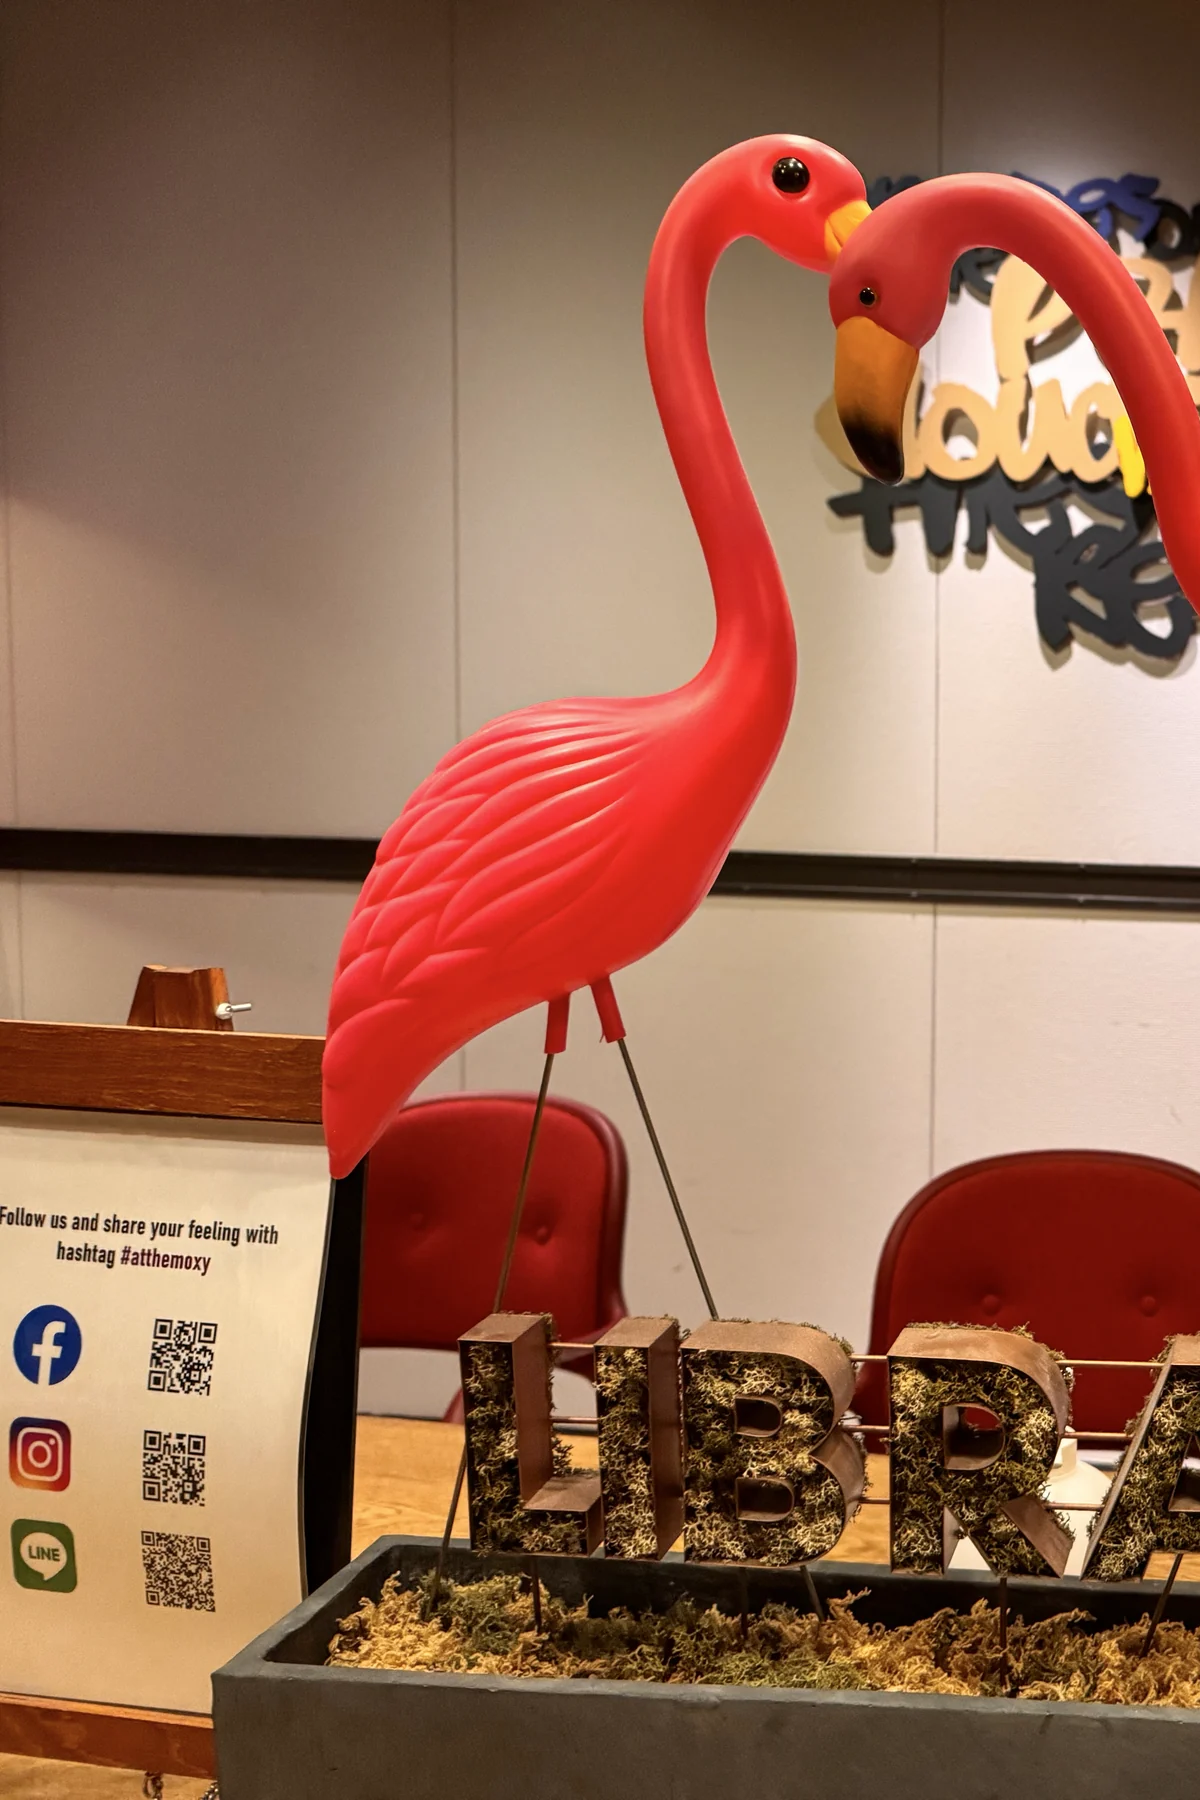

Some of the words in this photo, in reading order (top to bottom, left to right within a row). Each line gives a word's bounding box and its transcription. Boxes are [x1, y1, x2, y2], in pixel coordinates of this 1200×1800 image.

[0, 1206, 46, 1228] Follow
[51, 1214, 67, 1229] us
[72, 1213, 99, 1232] and
[103, 1214, 146, 1235] share
[150, 1221, 184, 1241] your
[188, 1220, 241, 1247] feeling
[246, 1224, 279, 1245] with
[56, 1241, 116, 1268] hashtag
[120, 1246, 211, 1276] #atthemoxy
[28, 1545, 60, 1562] LINE
